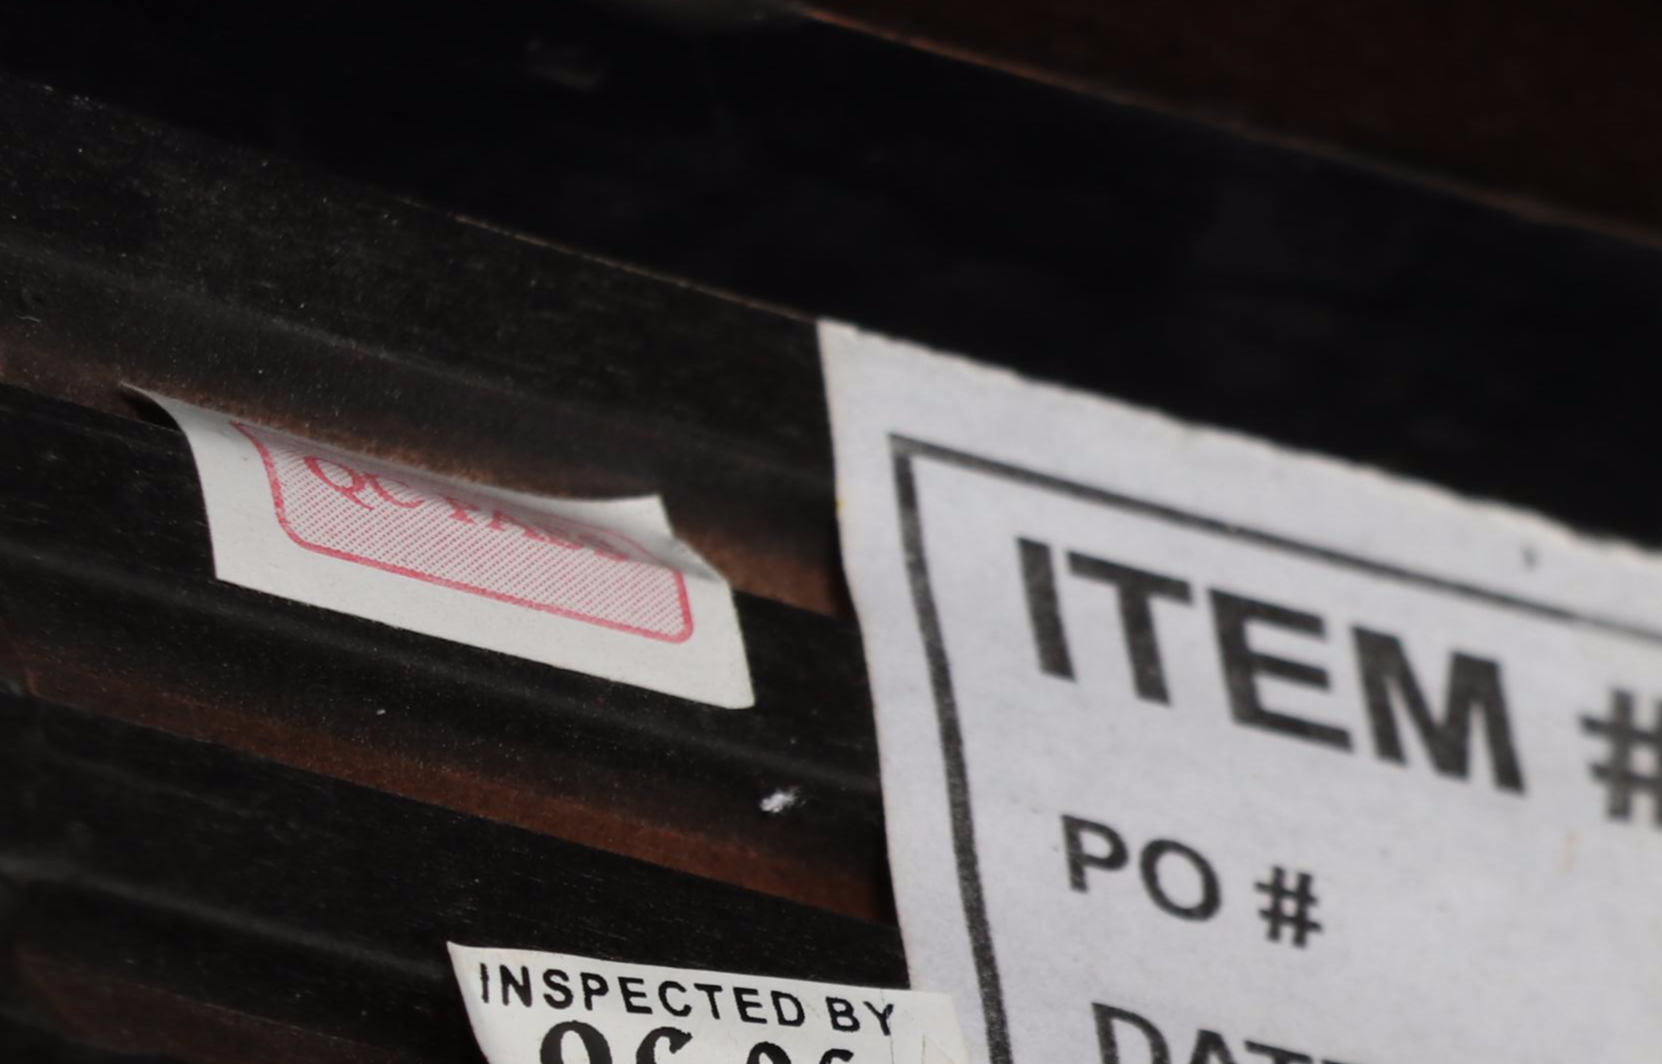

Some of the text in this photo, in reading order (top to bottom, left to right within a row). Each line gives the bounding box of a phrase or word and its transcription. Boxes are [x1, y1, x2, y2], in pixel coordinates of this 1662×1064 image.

[1016, 536, 1526, 796] ITEM
[1061, 813, 1222, 922] PO
[1254, 864, 1324, 948] #
[479, 962, 894, 1036] INSPECTED BY
